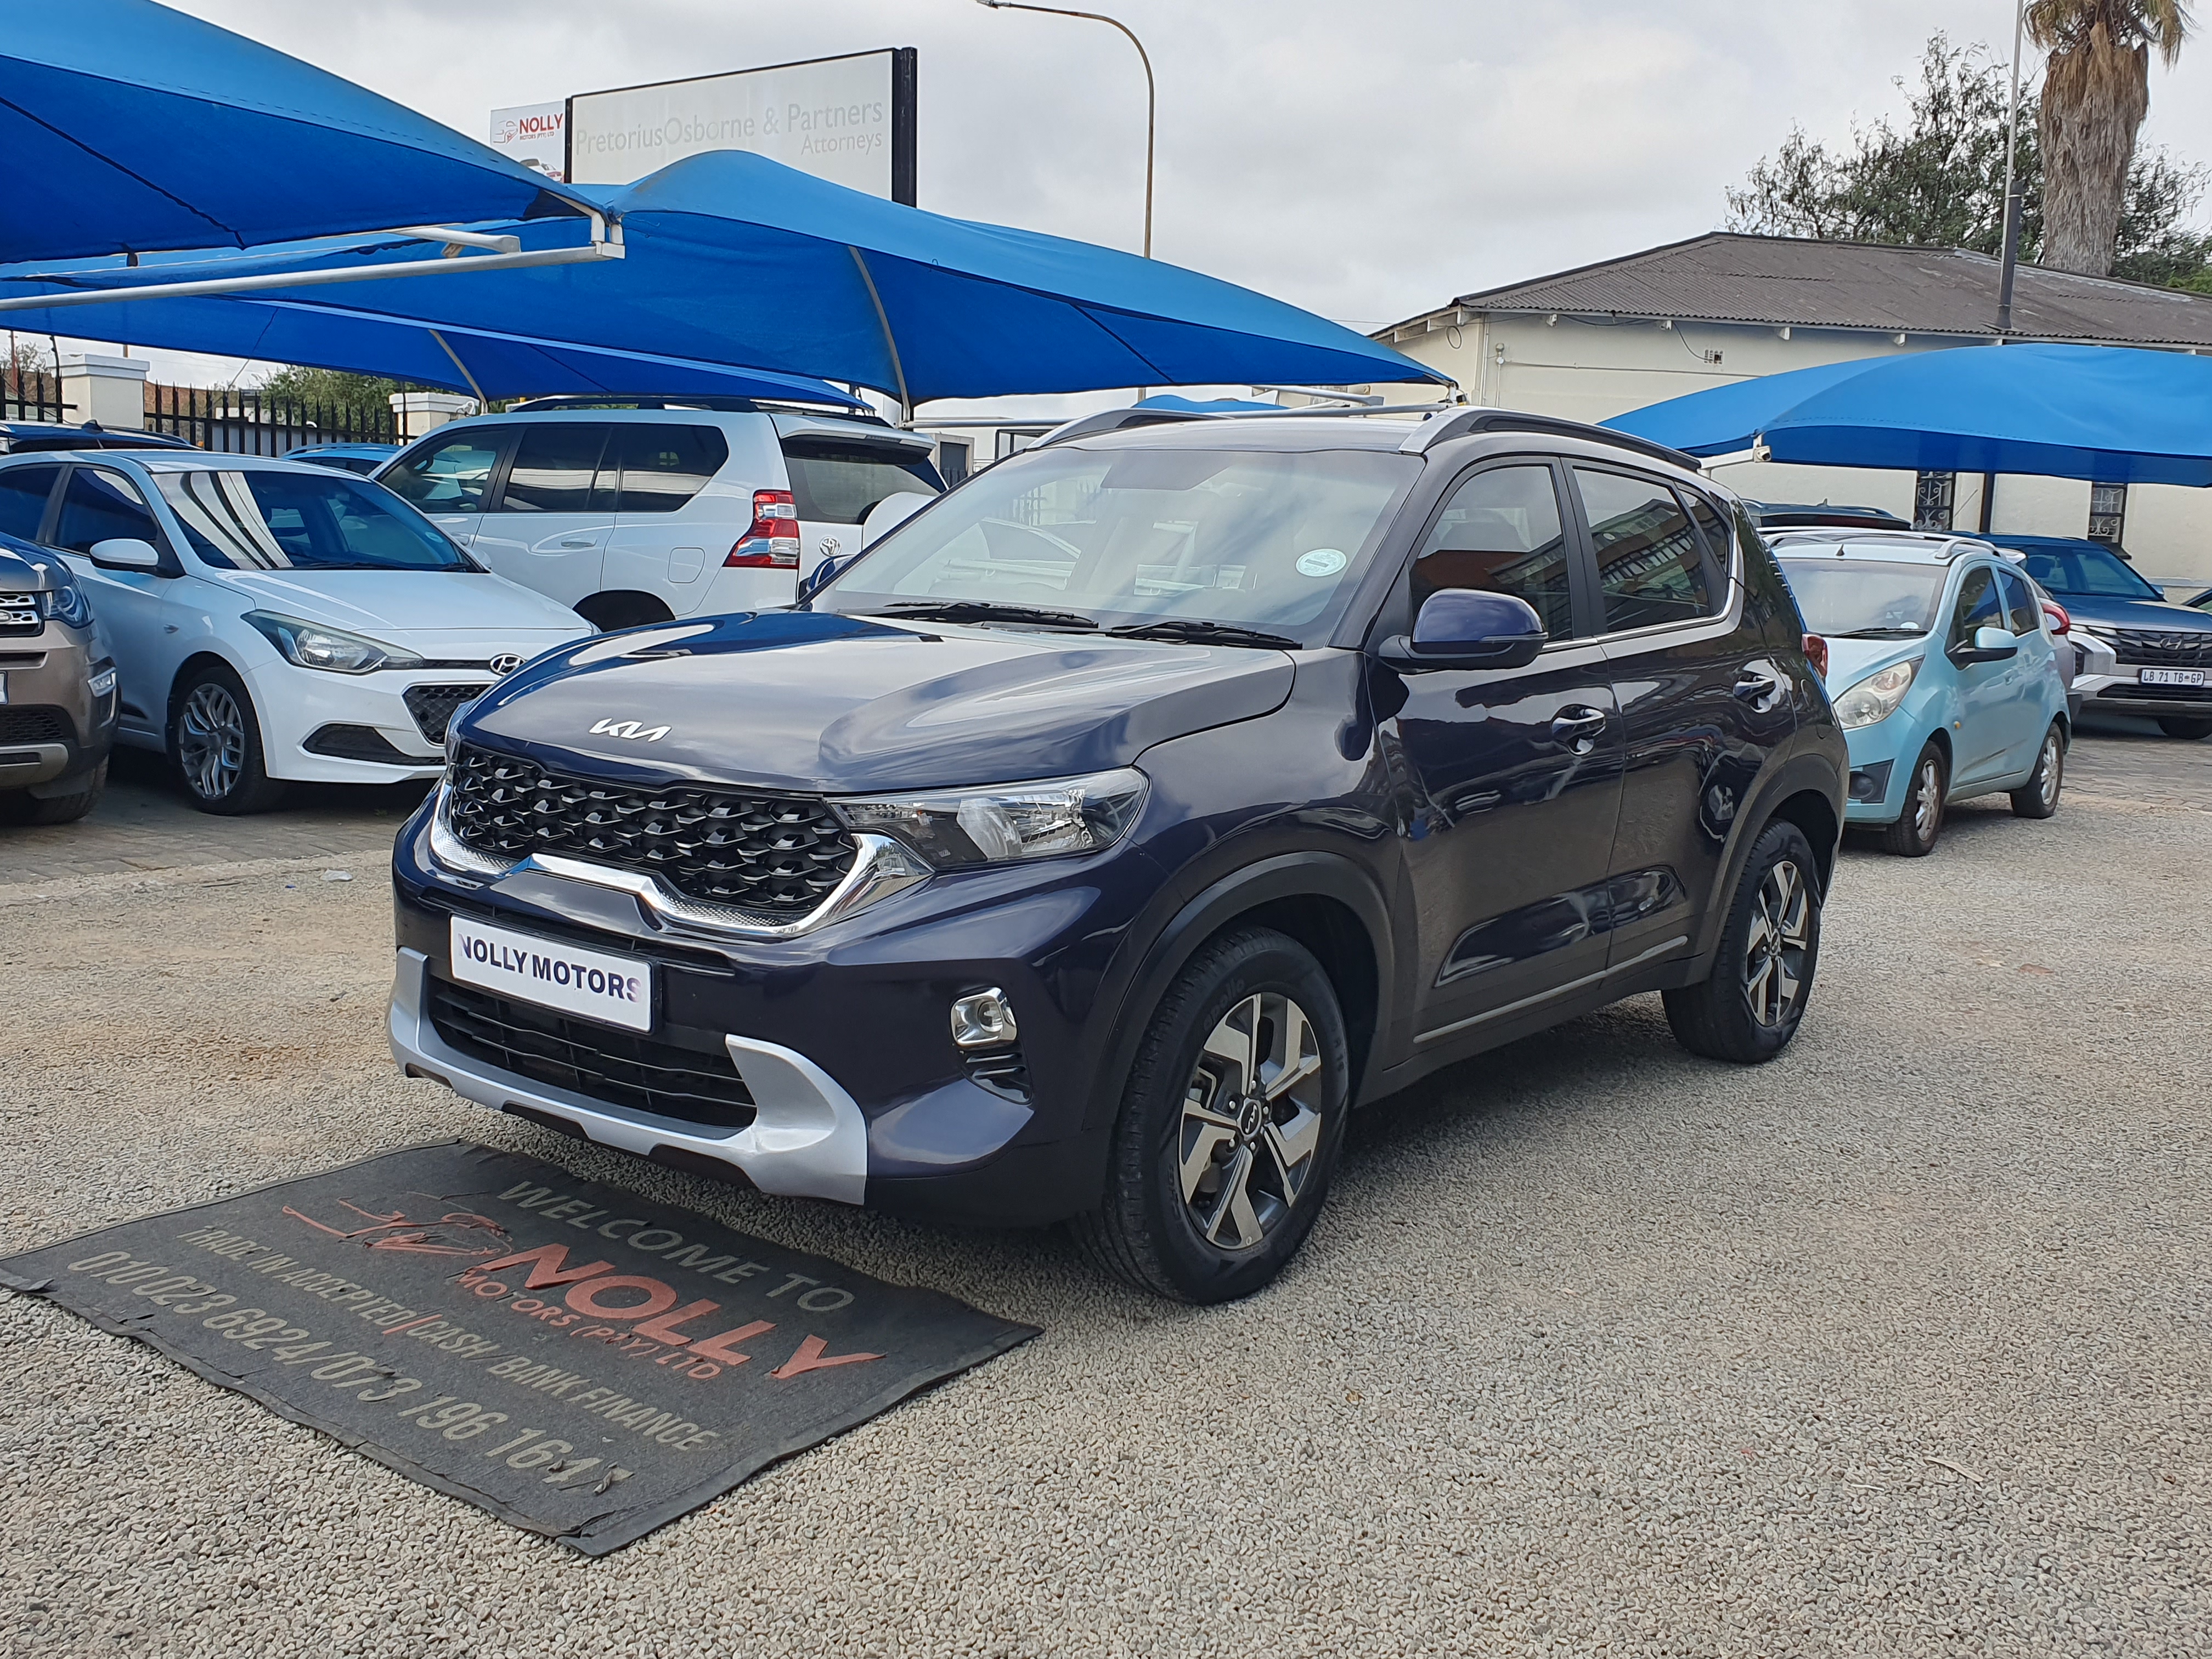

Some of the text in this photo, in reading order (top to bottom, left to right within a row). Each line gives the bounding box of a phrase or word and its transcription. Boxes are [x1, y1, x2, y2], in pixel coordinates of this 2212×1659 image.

[520, 113, 563, 134] NOLLY
[763, 107, 779, 136] &
[787, 101, 883, 133] Partners
[800, 133, 882, 155] Attorneys
[2143, 671, 2202, 684] LB 71 TB GP
[458, 933, 642, 1003] NOLLY MOTORS
[496, 1181, 855, 1312] WELCOME TO
[67, 1251, 170, 1284] 010
[132, 1276, 239, 1314] 023
[397, 1396, 509, 1440] 196
[176, 1225, 273, 1261] TRADE
[246, 1252, 300, 1273] IN
[567, 1386, 721, 1452] FINANCE
[464, 1243, 887, 1380] NOLLY
